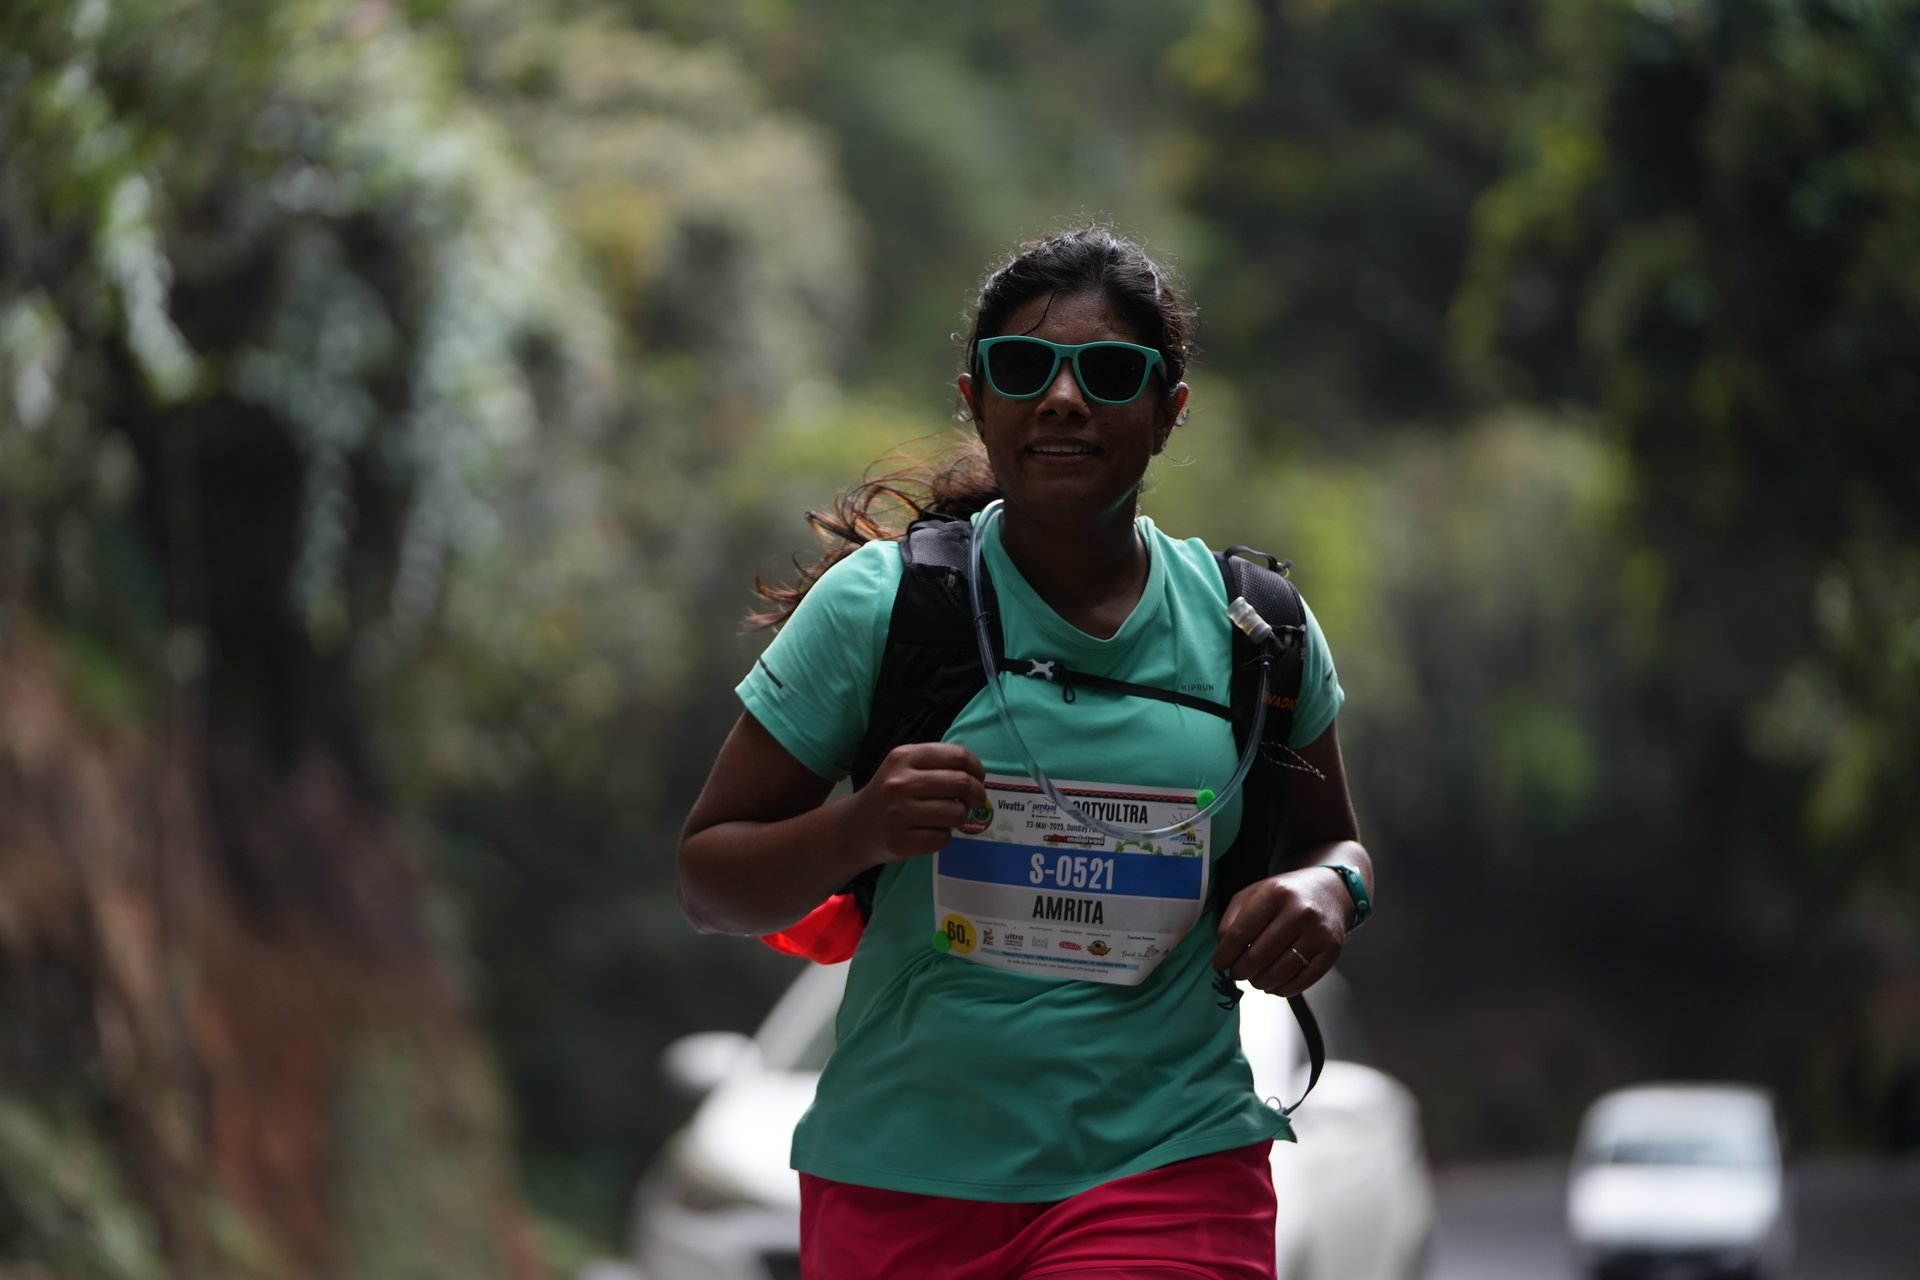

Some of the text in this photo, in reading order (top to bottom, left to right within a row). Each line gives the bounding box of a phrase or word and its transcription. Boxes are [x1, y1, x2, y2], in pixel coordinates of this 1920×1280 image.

[1181, 683, 1214, 692] KIPRUN
[998, 800, 1025, 812] Vivatta
[1026, 821, 1066, 832] 23-Mar-2025,
[1067, 824, 1087, 833] Sunday
[1029, 853, 1114, 890] S-0521
[1032, 895, 1104, 925] AMRITA
[947, 920, 966, 944] 60
[1005, 932, 1023, 941] ultra
